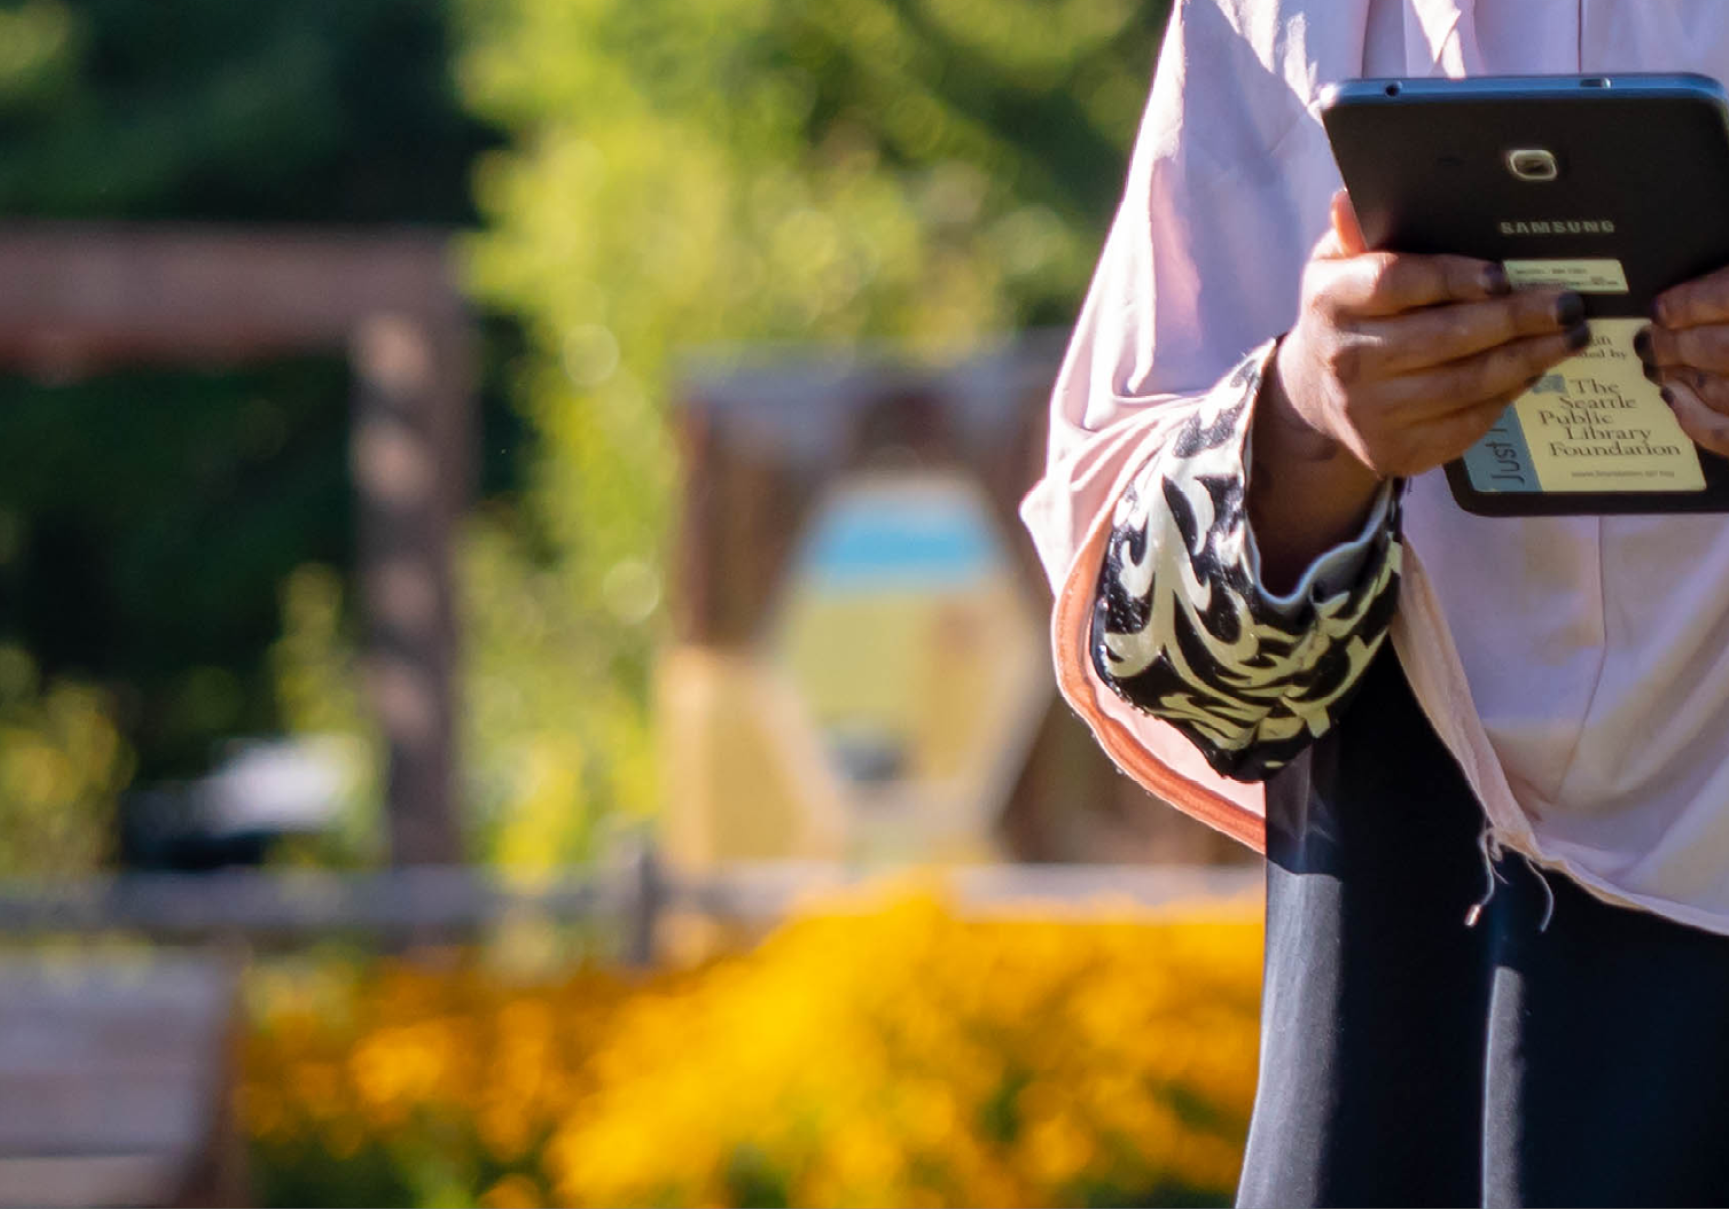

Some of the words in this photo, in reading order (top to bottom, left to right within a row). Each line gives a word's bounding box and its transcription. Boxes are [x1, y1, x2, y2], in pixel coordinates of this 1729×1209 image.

[1500, 220, 1615, 234] SAMSUNG
[1610, 349, 1626, 360] by
[1569, 378, 1619, 394] The
[1559, 393, 1638, 409] Seattle
[1538, 408, 1614, 425] Public
[1564, 425, 1652, 443] Library
[1549, 439, 1682, 456] Foundation
[1484, 442, 1525, 485] Just
